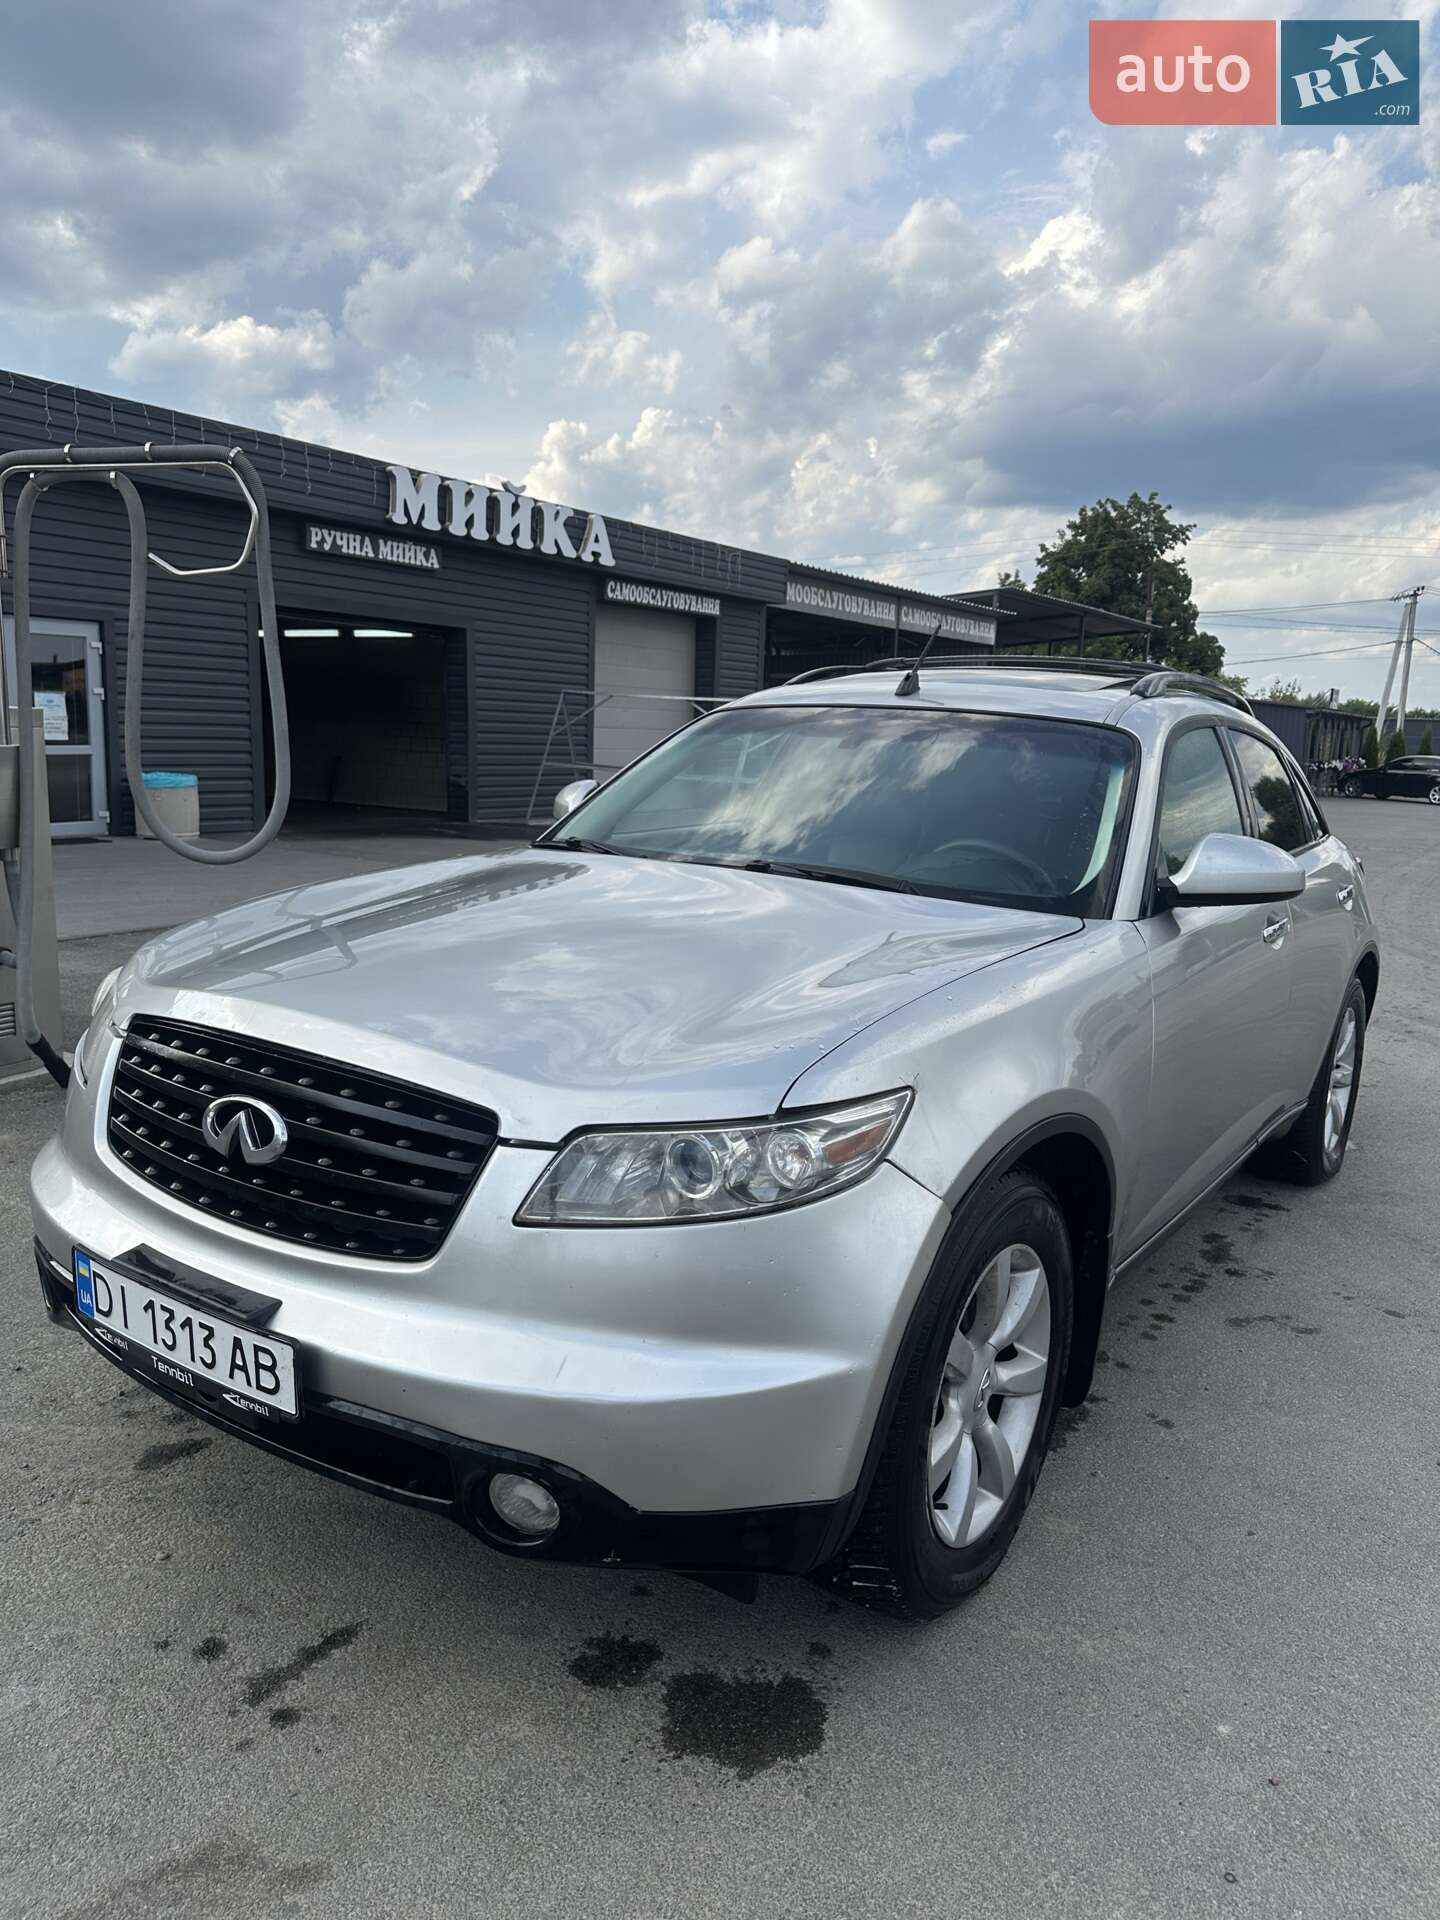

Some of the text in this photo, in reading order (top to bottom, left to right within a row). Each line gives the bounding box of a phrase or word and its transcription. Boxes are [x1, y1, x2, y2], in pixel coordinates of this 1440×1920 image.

[386, 465, 616, 567] МИЙКА
[309, 526, 440, 569] РУЧНА МИЙКА
[607, 580, 721, 615] САМООБСЛУГОВУВАННЯ
[786, 581, 896, 621] МООБСЛУГОВУВАННЯ
[81, 1292, 92, 1307] UA
[93, 1269, 281, 1395] DI 1313 AB
[151, 1355, 194, 1387] Tennbil
